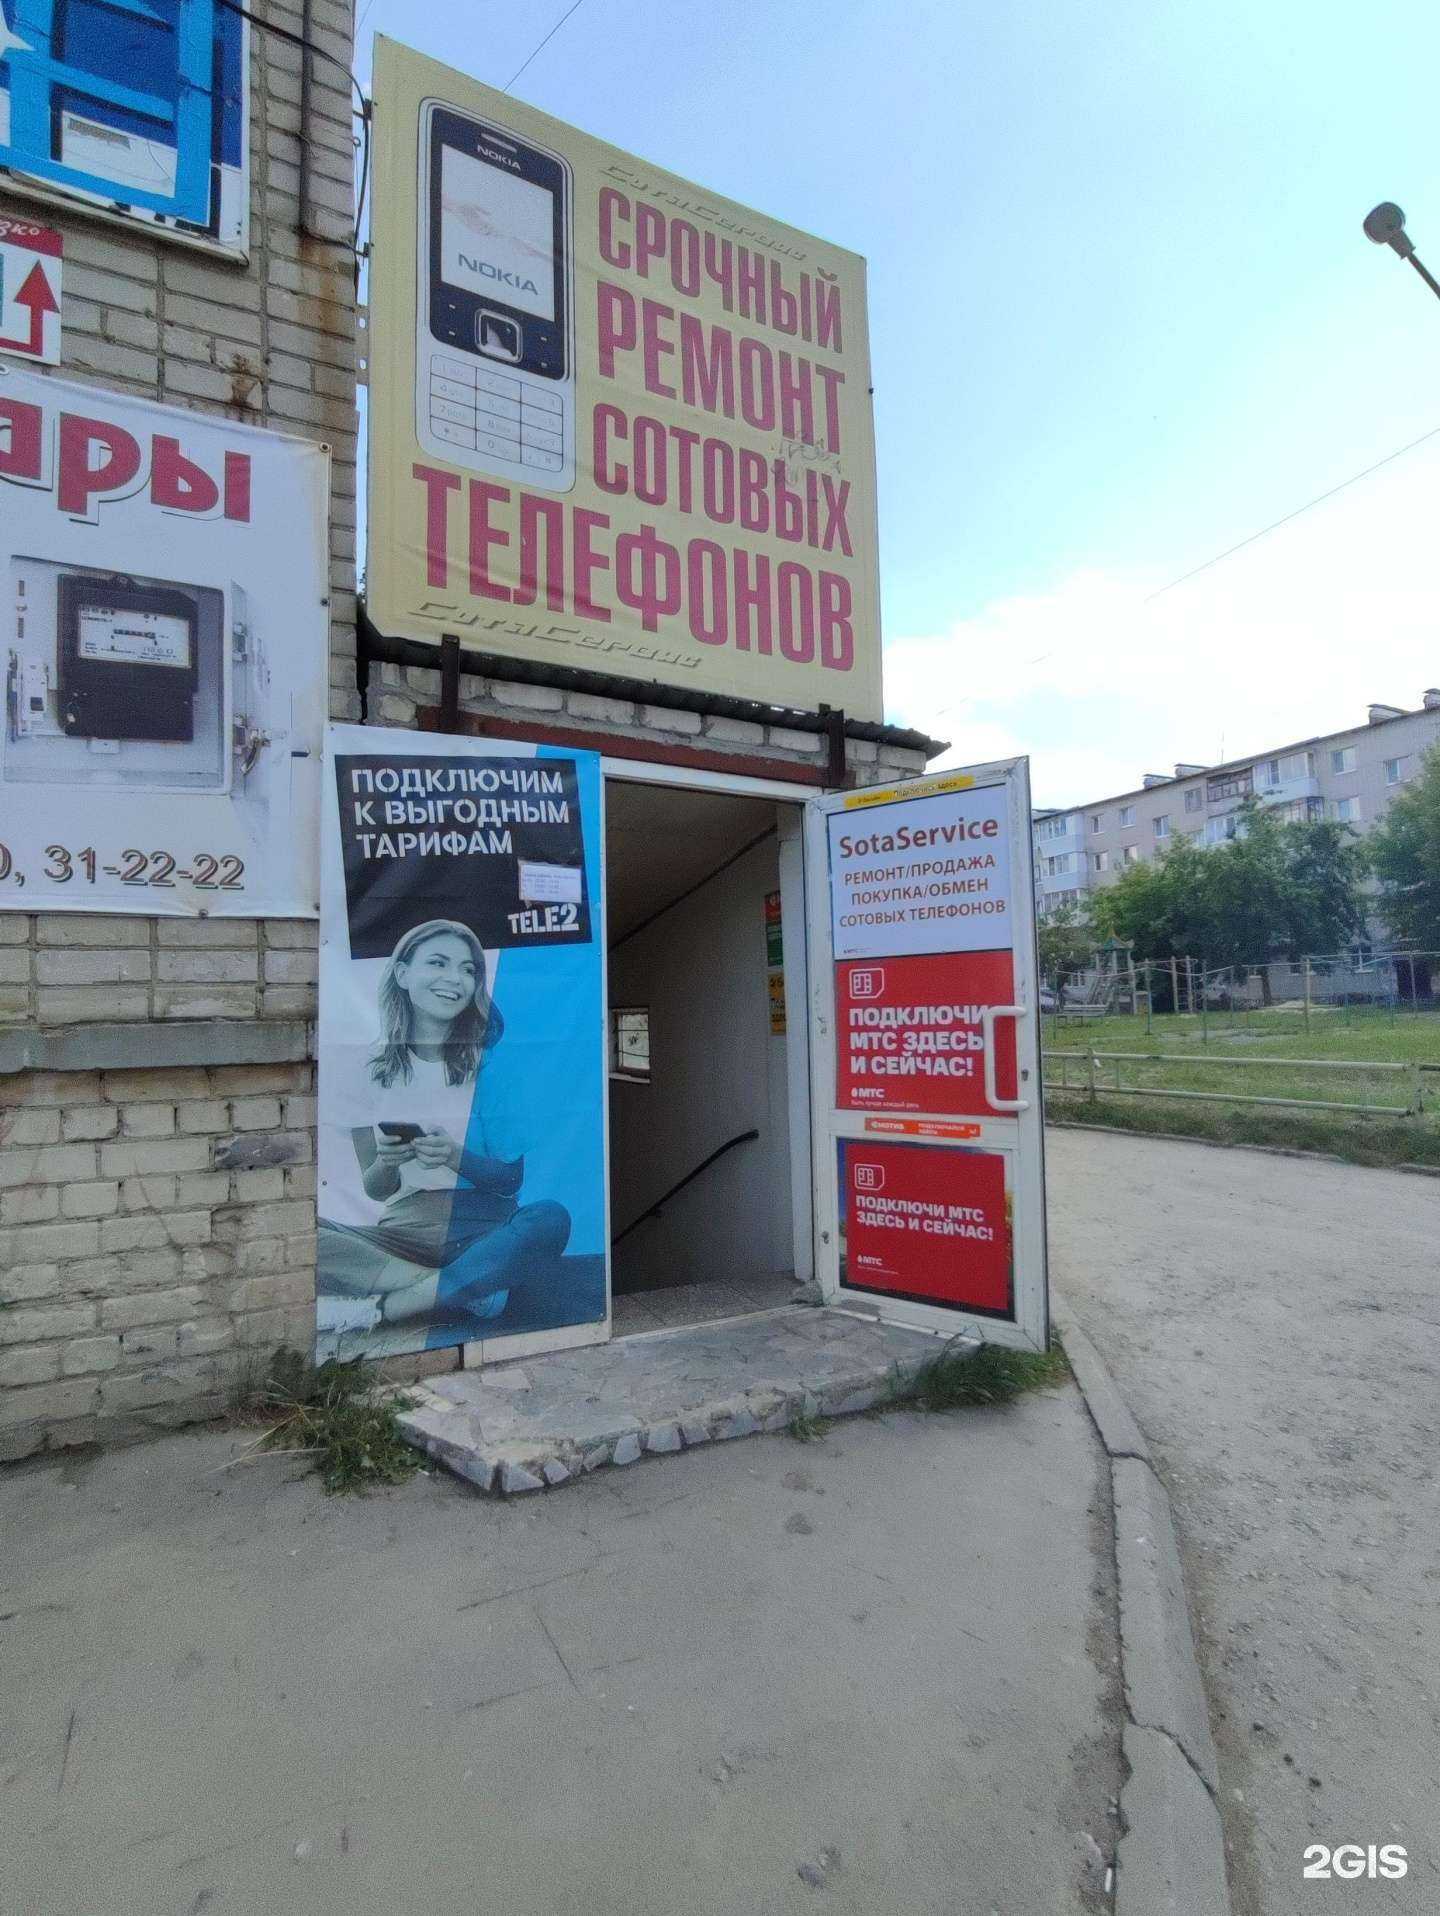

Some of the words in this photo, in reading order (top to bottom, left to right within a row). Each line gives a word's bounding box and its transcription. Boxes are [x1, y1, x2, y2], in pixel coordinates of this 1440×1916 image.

[477, 144, 521, 171] NOKIA
[458, 253, 538, 296] NOKIA
[599, 186, 843, 353] СРОЧНЫЙ
[597, 280, 845, 454] РЕМОНТ
[593, 402, 853, 557] СОТОВЫХ
[412, 463, 854, 672] ТЕЛЕФОНОВ
[351, 768, 563, 798] ПОДКЛЮЧИМ
[354, 801, 376, 826] К
[385, 799, 569, 828] ВЫГОДНЫМ
[356, 830, 513, 859] ТАРИФАМ
[839, 816, 999, 859] SotaService
[44, 845, 244, 890] 31-22-22
[844, 854, 996, 886] РЕМОНТ/ПРОДАЖА
[851, 878, 989, 905] ПОКУПКА/ОБМЕН
[508, 903, 580, 934] TELE2
[839, 907, 905, 928] СОТОВЫХ
[910, 900, 1006, 921] ТЕЛЕФОНОВ
[850, 1032, 897, 1050] МТС
[903, 1031, 984, 1054] ЗДЕСЬ
[850, 1057, 866, 1074] И
[871, 1052, 974, 1077] СЕЙЧАС!
[858, 1087, 885, 1098] МТС
[856, 1194, 945, 1216] ПОДКЛЮЧИ
[949, 1206, 985, 1222] МТС
[856, 1211, 905, 1229] ЗДЕСЬ
[908, 1216, 919, 1230] И
[923, 1219, 994, 1241] СЕЙЧАС!
[863, 1255, 883, 1266] МТС
